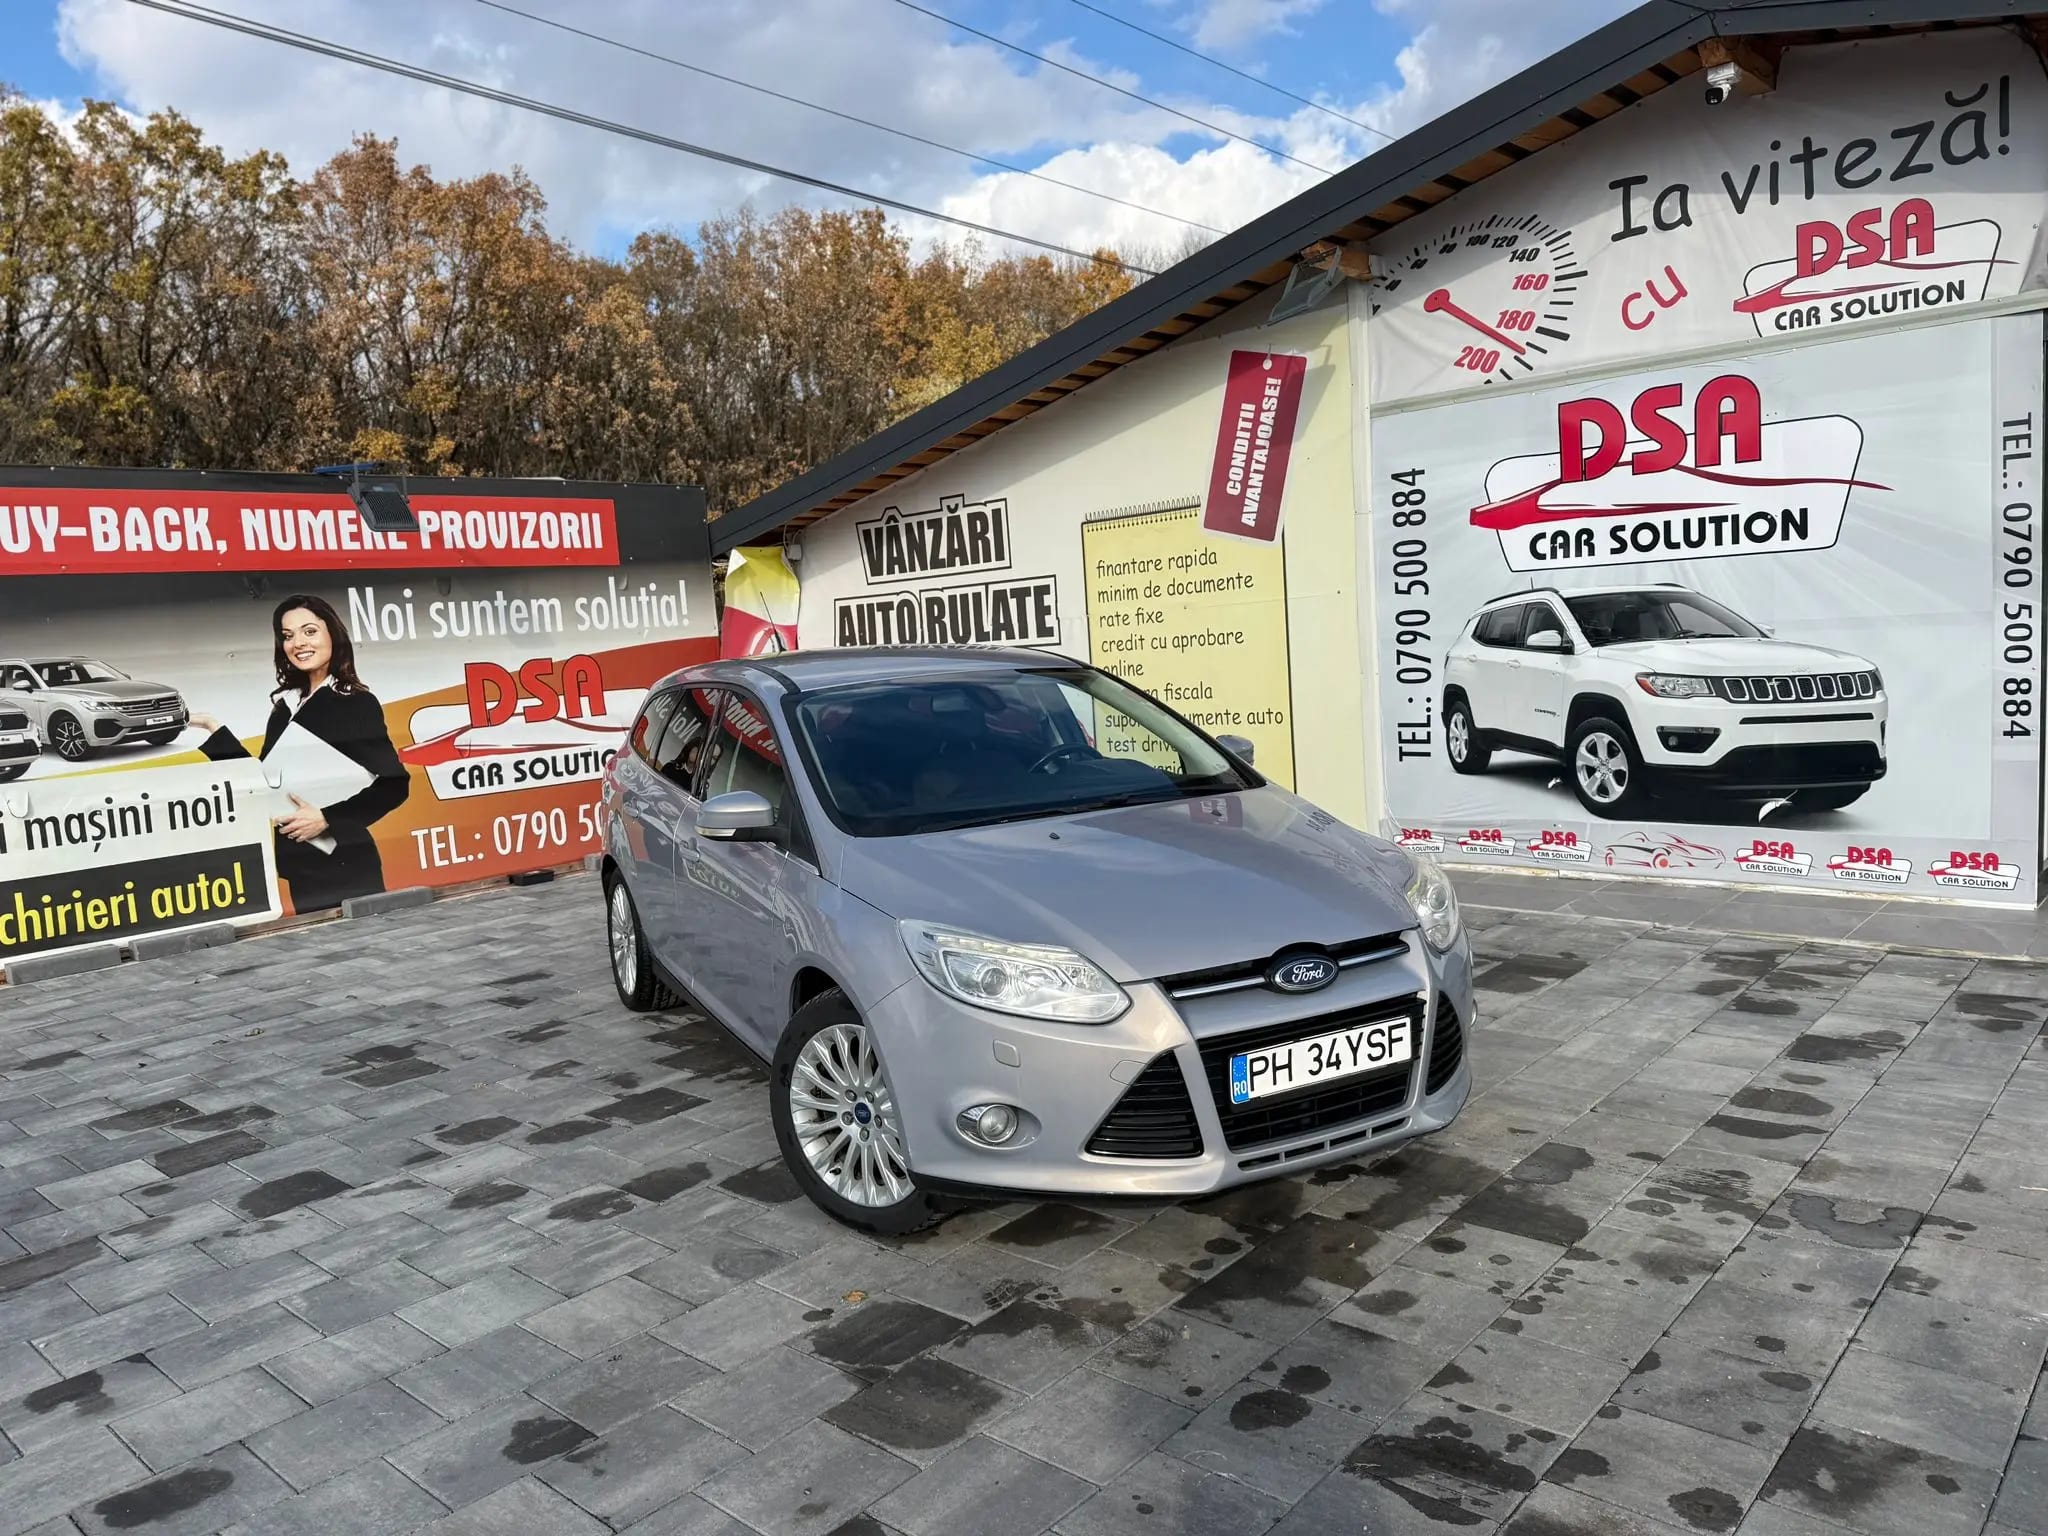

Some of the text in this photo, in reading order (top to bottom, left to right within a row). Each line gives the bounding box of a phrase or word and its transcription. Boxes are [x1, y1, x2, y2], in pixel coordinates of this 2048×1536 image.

[1608, 75, 2010, 242] Ia viteză!
[1465, 234, 1490, 246] 100
[1491, 235, 1519, 248] 120
[1797, 197, 1935, 278] DSA
[1509, 248, 1541, 262] 140
[1512, 273, 1549, 291] 160
[1621, 265, 1688, 330] cu
[1774, 279, 1965, 331] CAR SOLUTION
[1496, 310, 1536, 331] 180
[1453, 346, 1500, 373] 200
[1558, 374, 1762, 483] DSA
[1226, 403, 1256, 496] CONDITII
[1241, 377, 1282, 527] AVANTAJOASE!
[0, 506, 228, 555] UY-BACK,
[417, 510, 603, 550] PROVIZORII
[862, 503, 1006, 577] VÂNZĂRI
[1529, 507, 1809, 561] CAR SOLUTION
[1096, 547, 1218, 579] finantare rapida
[2002, 412, 2033, 739] TEL.: 0790 500 884
[1097, 572, 1254, 603] minim de documente
[348, 576, 690, 642] Noi suntem soluția!
[838, 584, 1055, 647] AUTO RULATE
[1100, 607, 1164, 628] rate fixe
[1391, 468, 1432, 762] TEL.: 0790 500 884
[1101, 628, 1244, 653] credit cu aprobare
[464, 654, 607, 728] DSA
[1164, 681, 1213, 701] fiscala
[1185, 709, 1242, 726] umente
[1247, 708, 1284, 725] auto
[1107, 737, 1137, 752] test
[452, 748, 617, 790] CAR SOLUTIO
[24, 791, 152, 852] mașini
[168, 781, 236, 830] noi!
[411, 802, 602, 870] TEL.: 0790 50
[1469, 829, 1503, 842] DSA
[1541, 830, 1577, 847] DSA
[1753, 840, 1795, 860] DSA
[1552, 852, 1585, 861] SOLUTION
[1745, 863, 1803, 875] CAR SOLUTION
[1847, 846, 1892, 866] DSA
[1950, 851, 2000, 871] DSA
[1840, 870, 1902, 882] CAR SOLUTION
[1942, 876, 2009, 888] CAR SOLUTION
[0, 862, 246, 945] chirieri auto!
[1291, 962, 1325, 984] Ford
[1249, 1048, 1293, 1092] PH
[1233, 1080, 1247, 1096] RO
